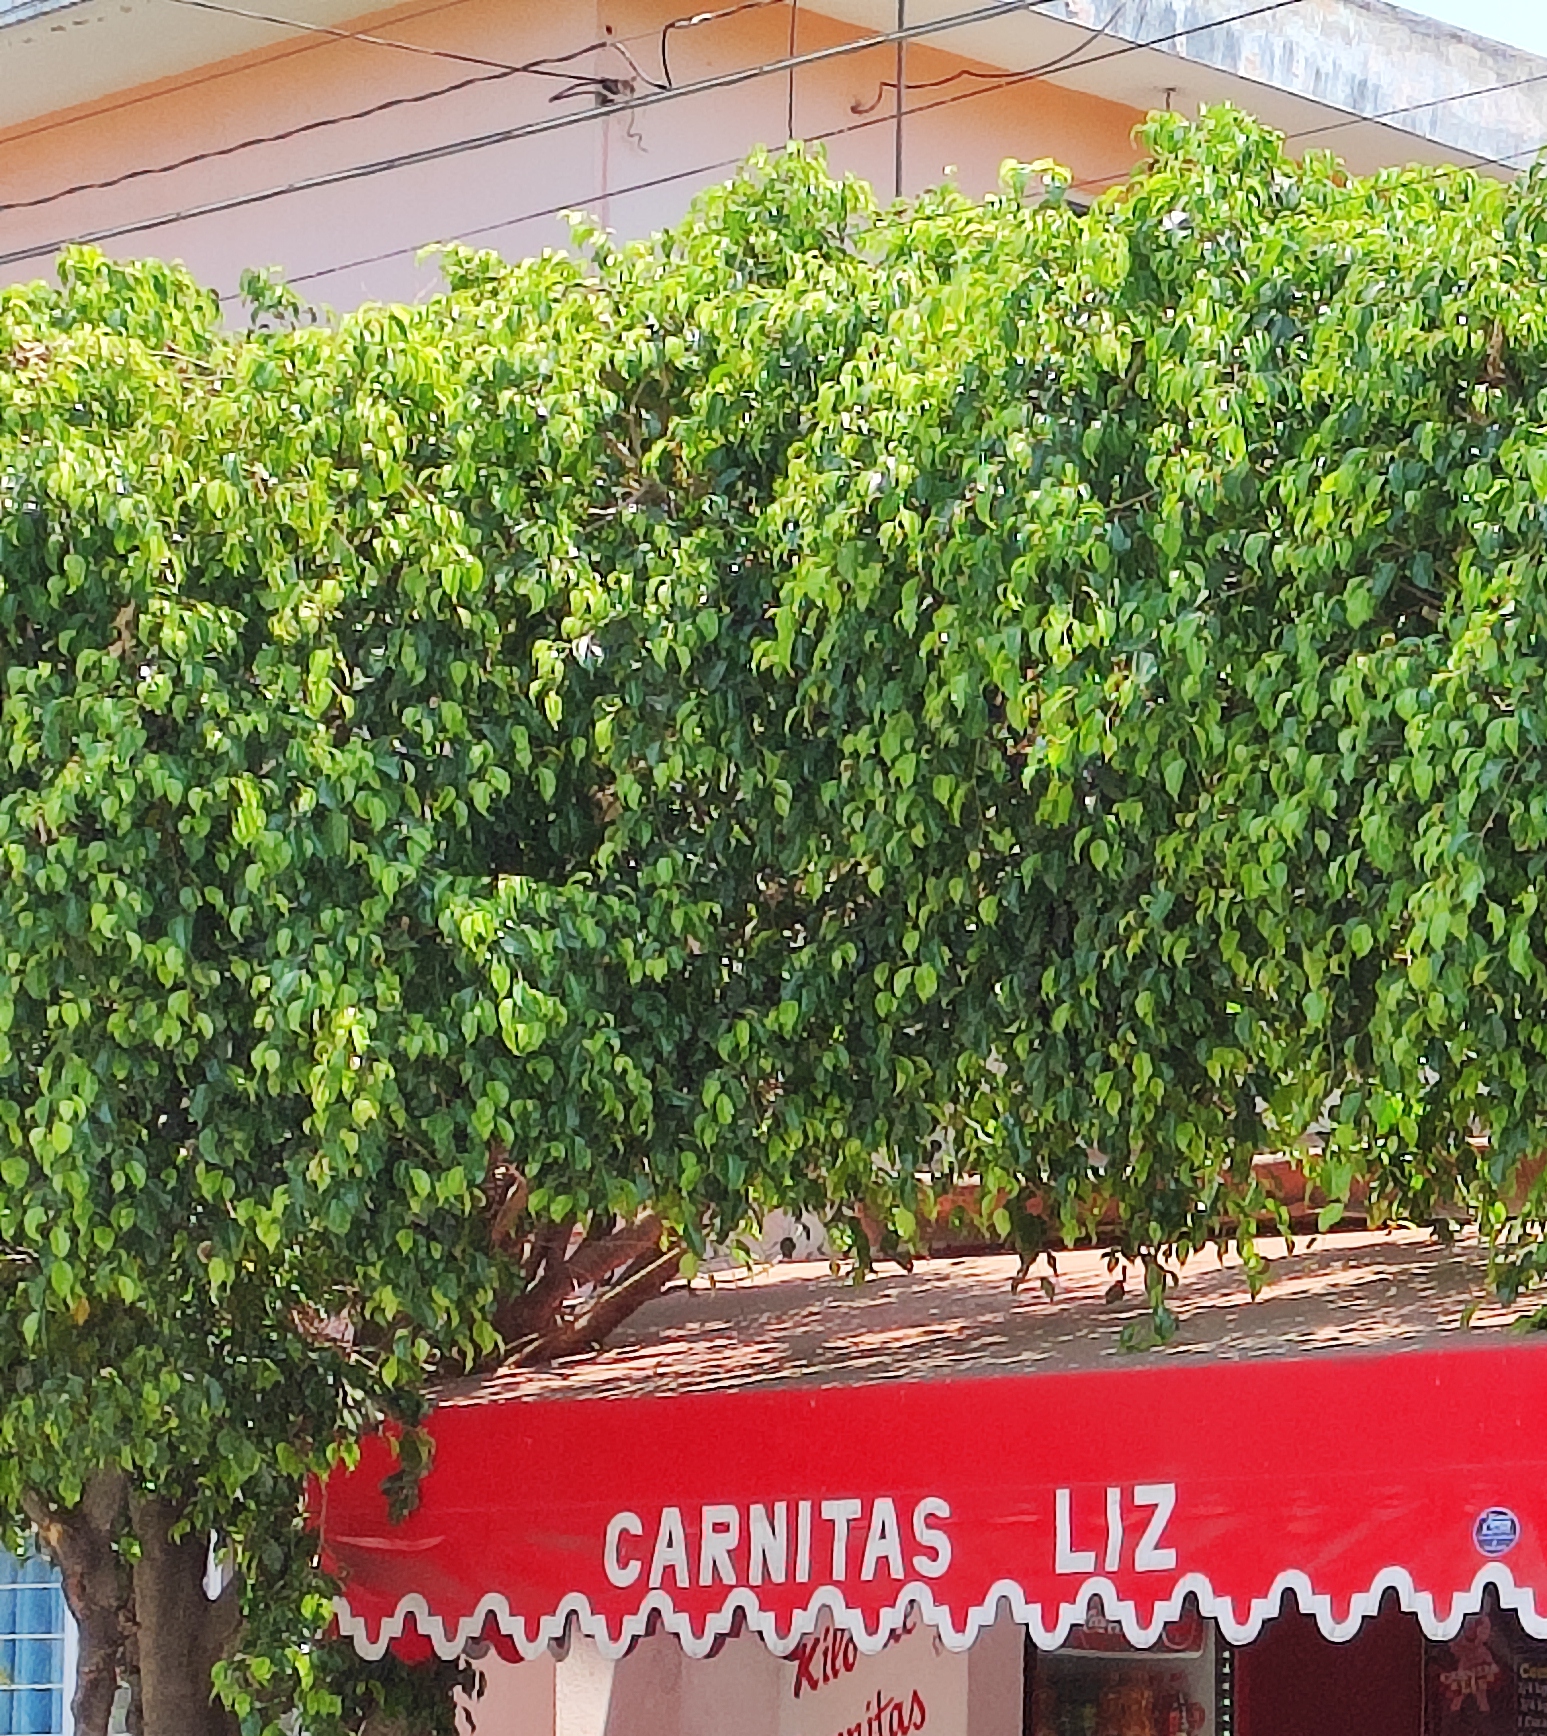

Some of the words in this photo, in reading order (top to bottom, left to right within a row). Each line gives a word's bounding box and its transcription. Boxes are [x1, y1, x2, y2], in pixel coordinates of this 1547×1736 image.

[603, 1497, 953, 1589] CARNITAS
[1054, 1483, 1178, 1574] LIZ
[793, 1625, 858, 1699] Kilo
